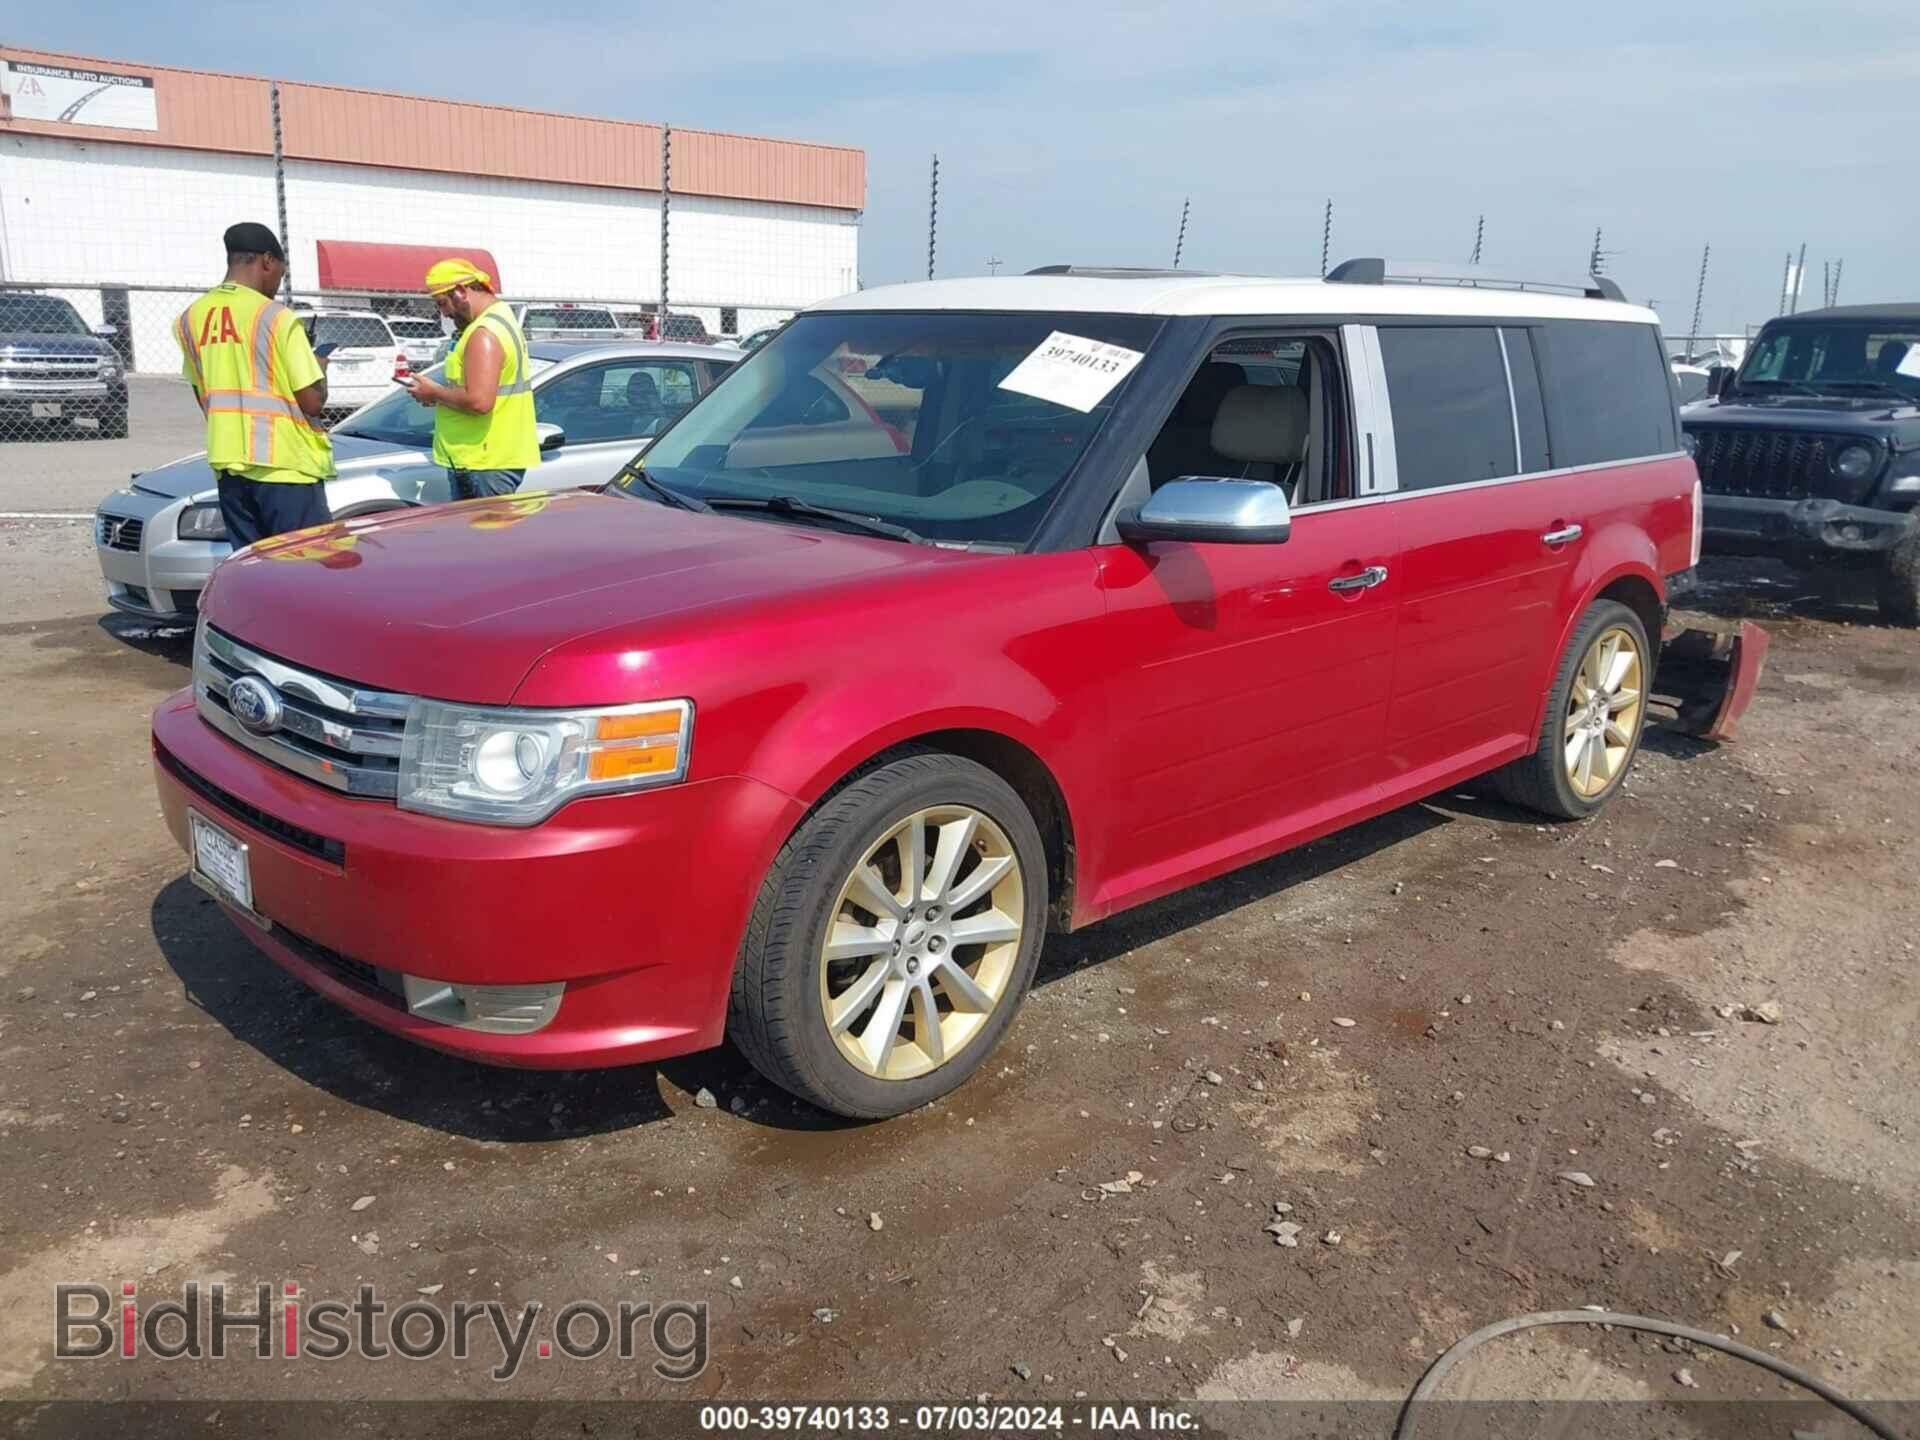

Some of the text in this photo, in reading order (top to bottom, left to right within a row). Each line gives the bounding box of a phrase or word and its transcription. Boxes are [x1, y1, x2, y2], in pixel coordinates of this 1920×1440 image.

[16, 65, 144, 87] INSURANCE AUTO AUCTIONS
[1041, 346, 1120, 373] 39740133
